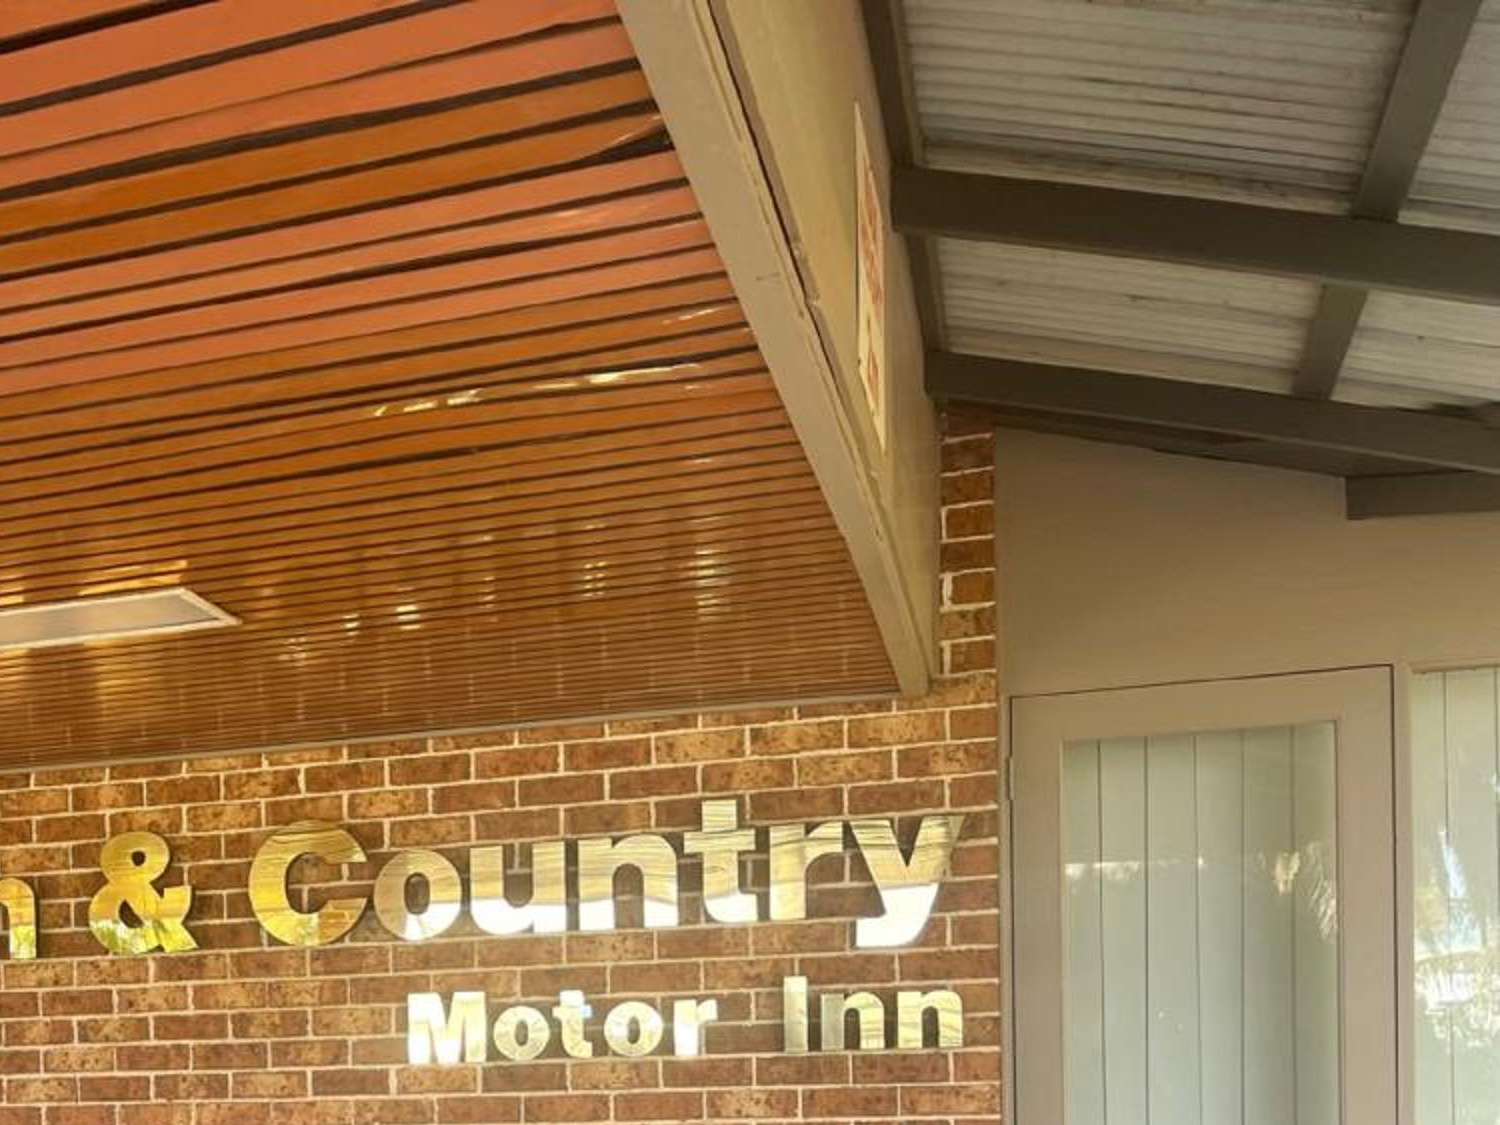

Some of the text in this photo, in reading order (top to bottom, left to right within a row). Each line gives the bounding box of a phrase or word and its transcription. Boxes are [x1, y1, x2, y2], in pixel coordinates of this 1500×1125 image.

[88, 831, 197, 955] &
[249, 799, 965, 948] Country
[407, 975, 964, 1065] Motor Inn
